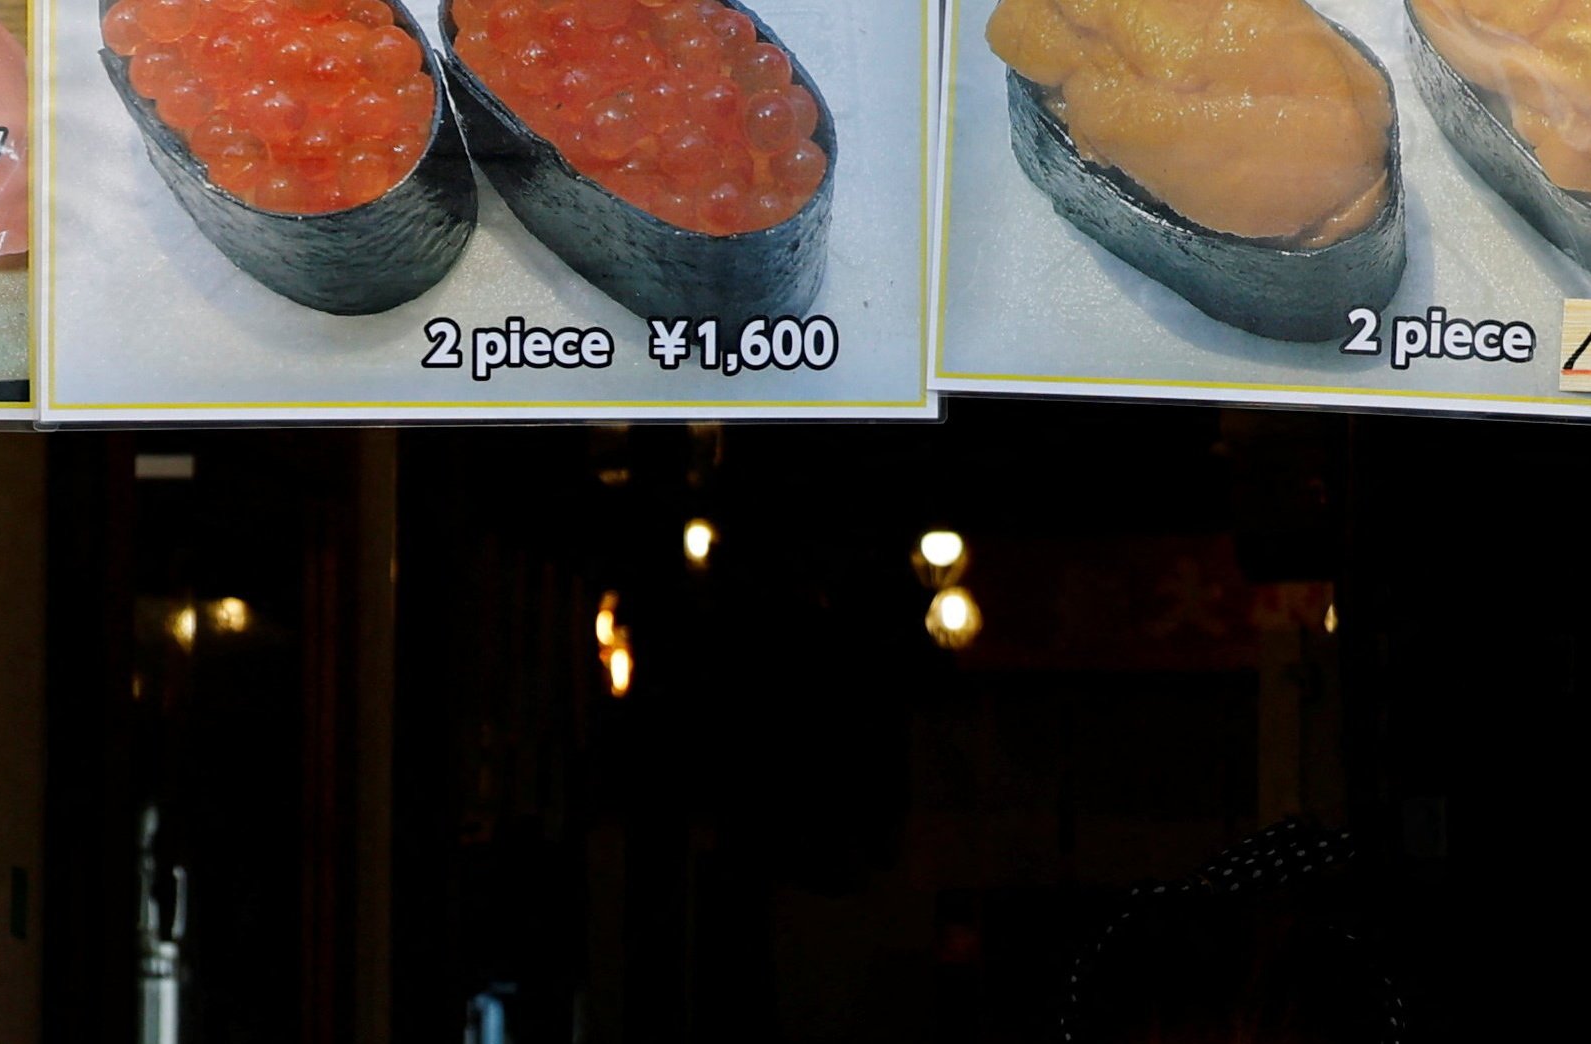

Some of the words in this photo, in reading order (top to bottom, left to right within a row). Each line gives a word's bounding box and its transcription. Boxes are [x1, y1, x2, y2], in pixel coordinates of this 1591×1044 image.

[425, 321, 461, 364] 2
[476, 321, 611, 378] piece
[652, 321, 835, 372] ¥1,600
[1343, 308, 1381, 353] 2
[1395, 311, 1534, 366] piece
